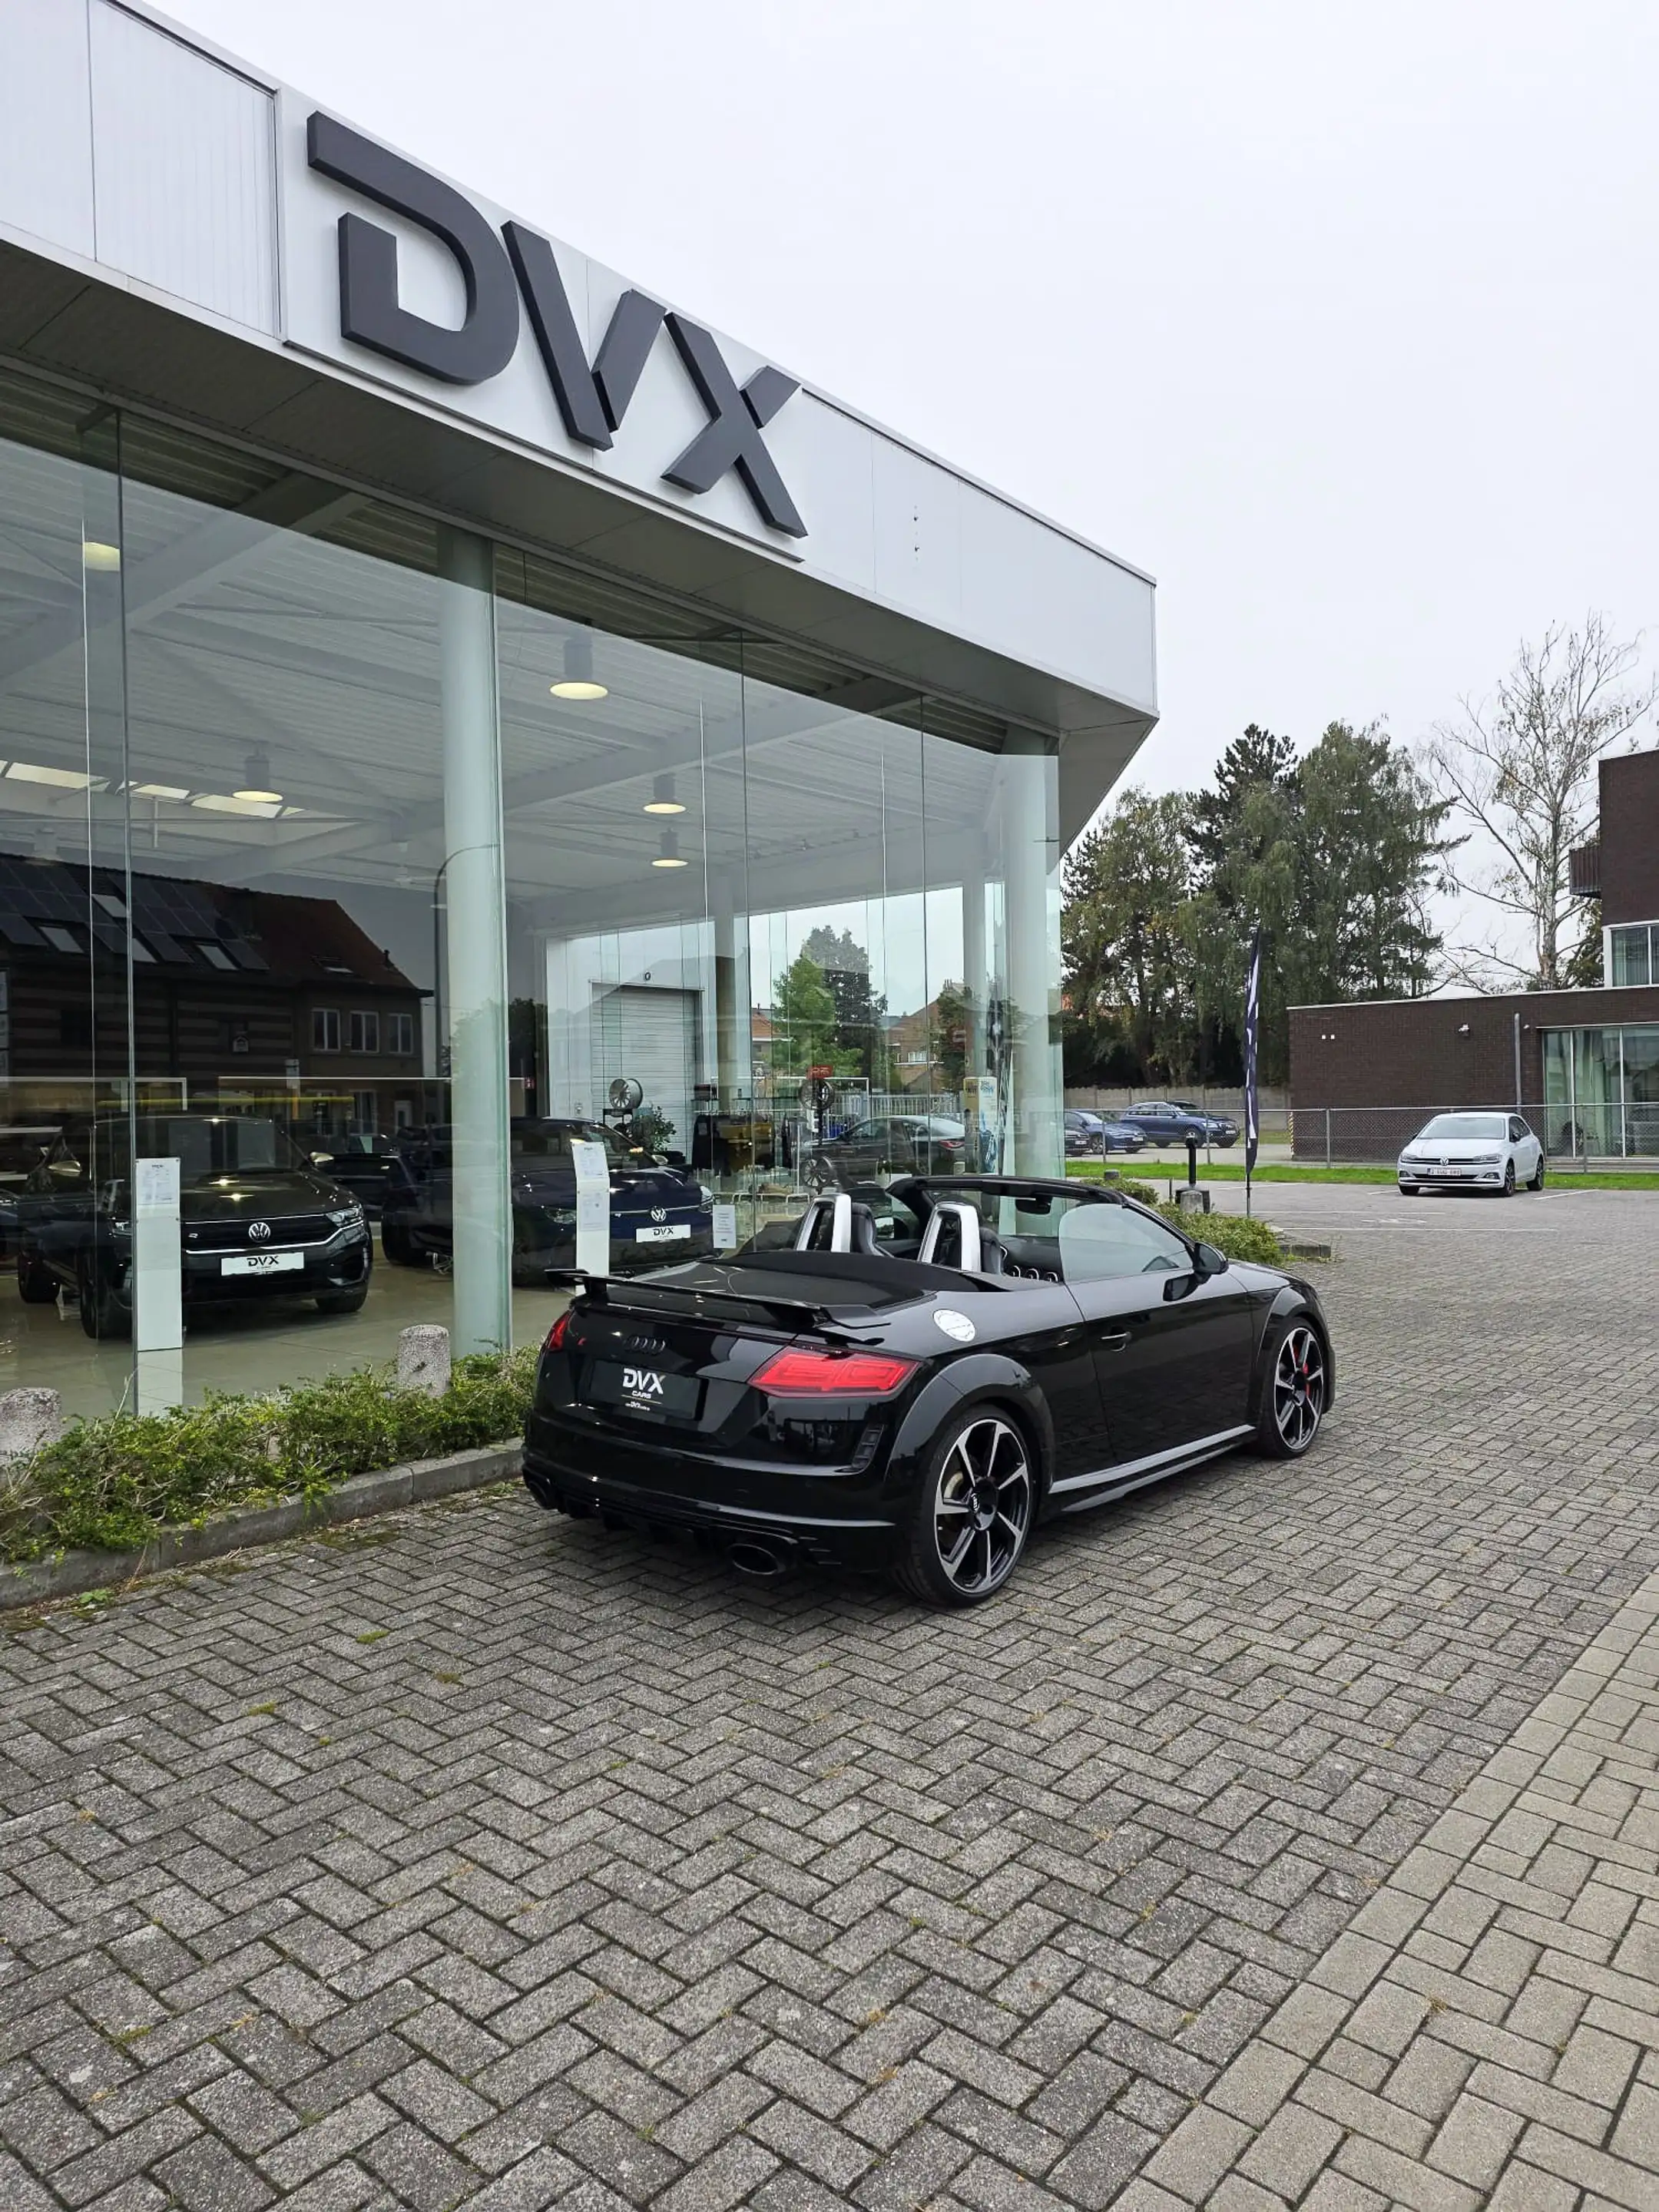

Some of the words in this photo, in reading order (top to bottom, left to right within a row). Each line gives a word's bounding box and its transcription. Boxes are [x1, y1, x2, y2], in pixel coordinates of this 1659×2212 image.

[307, 111, 808, 538] DVX
[653, 1227, 674, 1236] DVX
[247, 1255, 280, 1267] DVX
[622, 1368, 666, 1395] DVX
